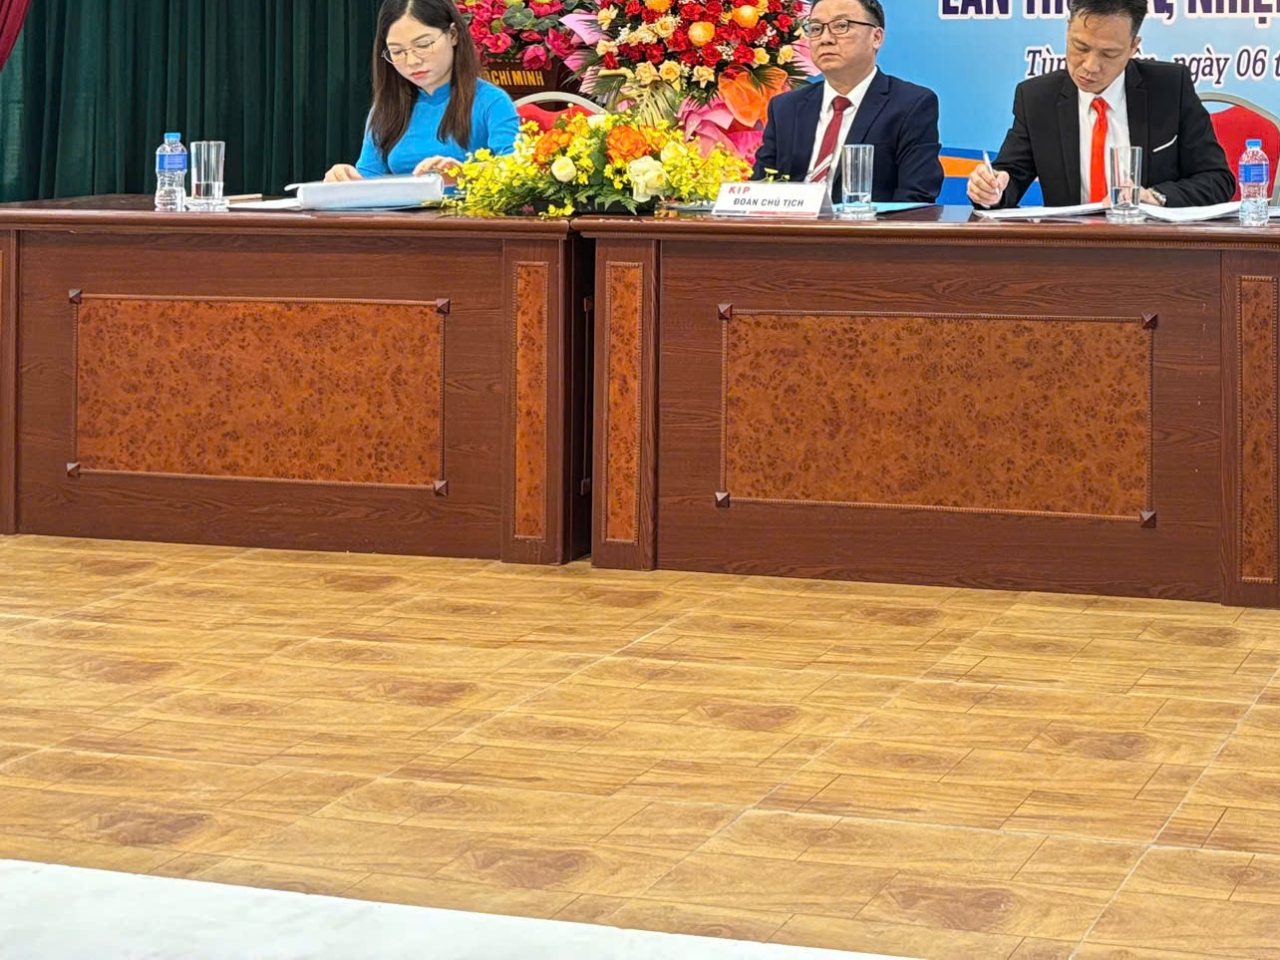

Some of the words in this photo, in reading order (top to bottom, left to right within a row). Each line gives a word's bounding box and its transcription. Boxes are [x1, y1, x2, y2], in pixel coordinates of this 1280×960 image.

[1026, 47, 1068, 76] Tùn
[1236, 48, 1267, 77] 06
[490, 67, 512, 86] CHÍ
[512, 70, 545, 86] MINH
[783, 199, 804, 208] TỊCH
